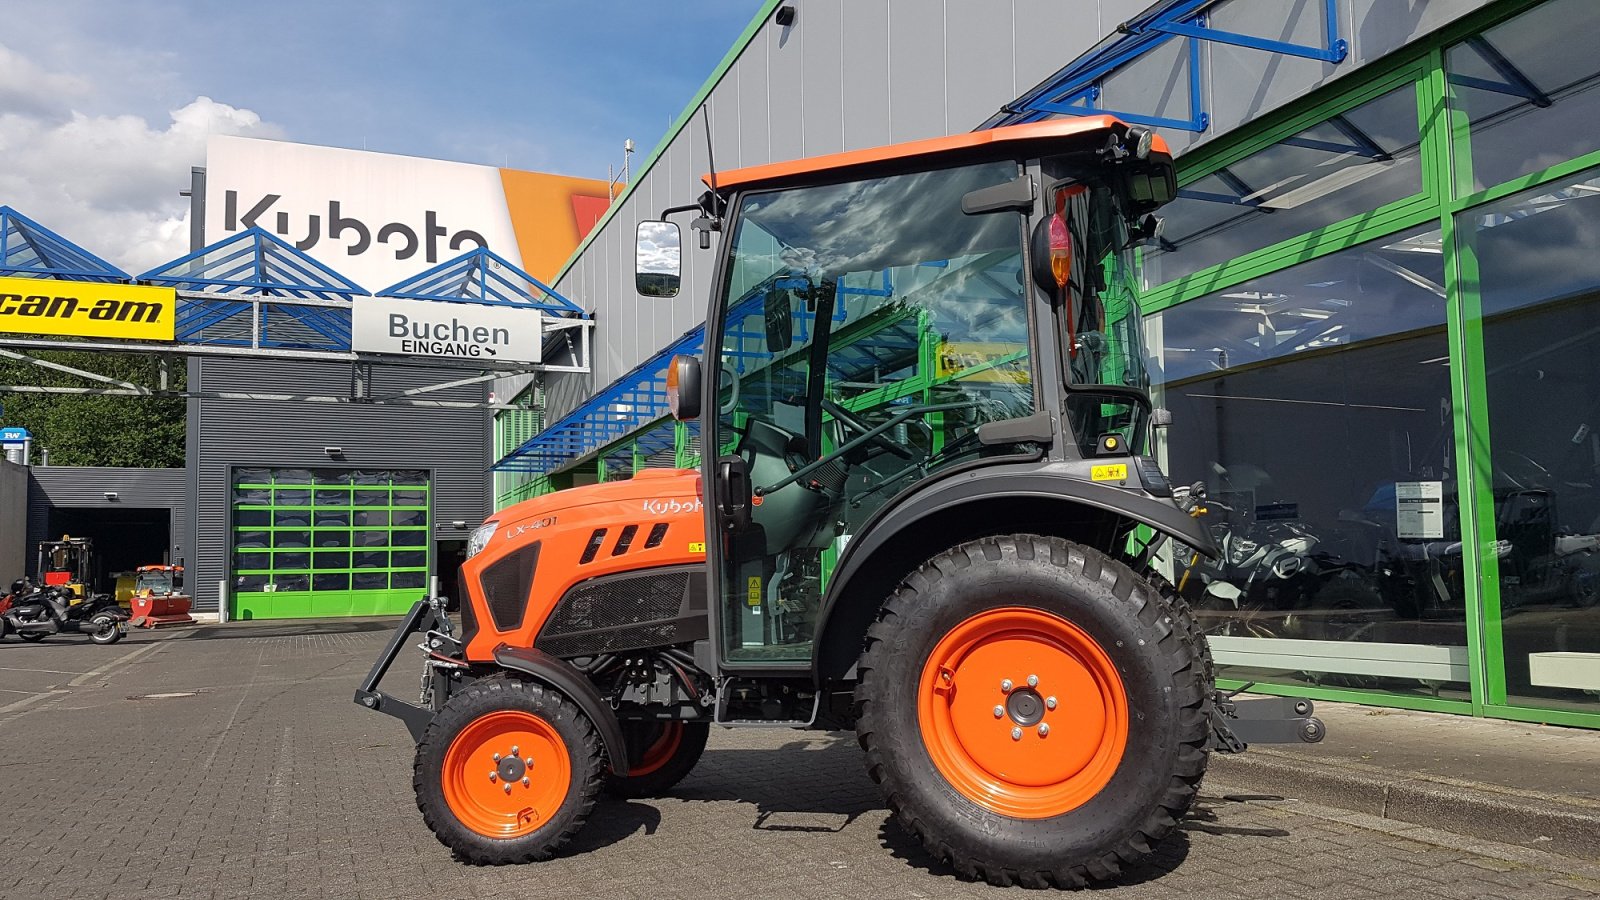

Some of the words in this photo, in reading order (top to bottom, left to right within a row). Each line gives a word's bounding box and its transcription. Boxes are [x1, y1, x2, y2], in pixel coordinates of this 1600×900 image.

[0, 293, 163, 323] can-am
[389, 313, 509, 345] Buchen
[402, 339, 480, 357] EINGANG
[643, 497, 703, 515] Kubot
[506, 516, 557, 539] LX-401
